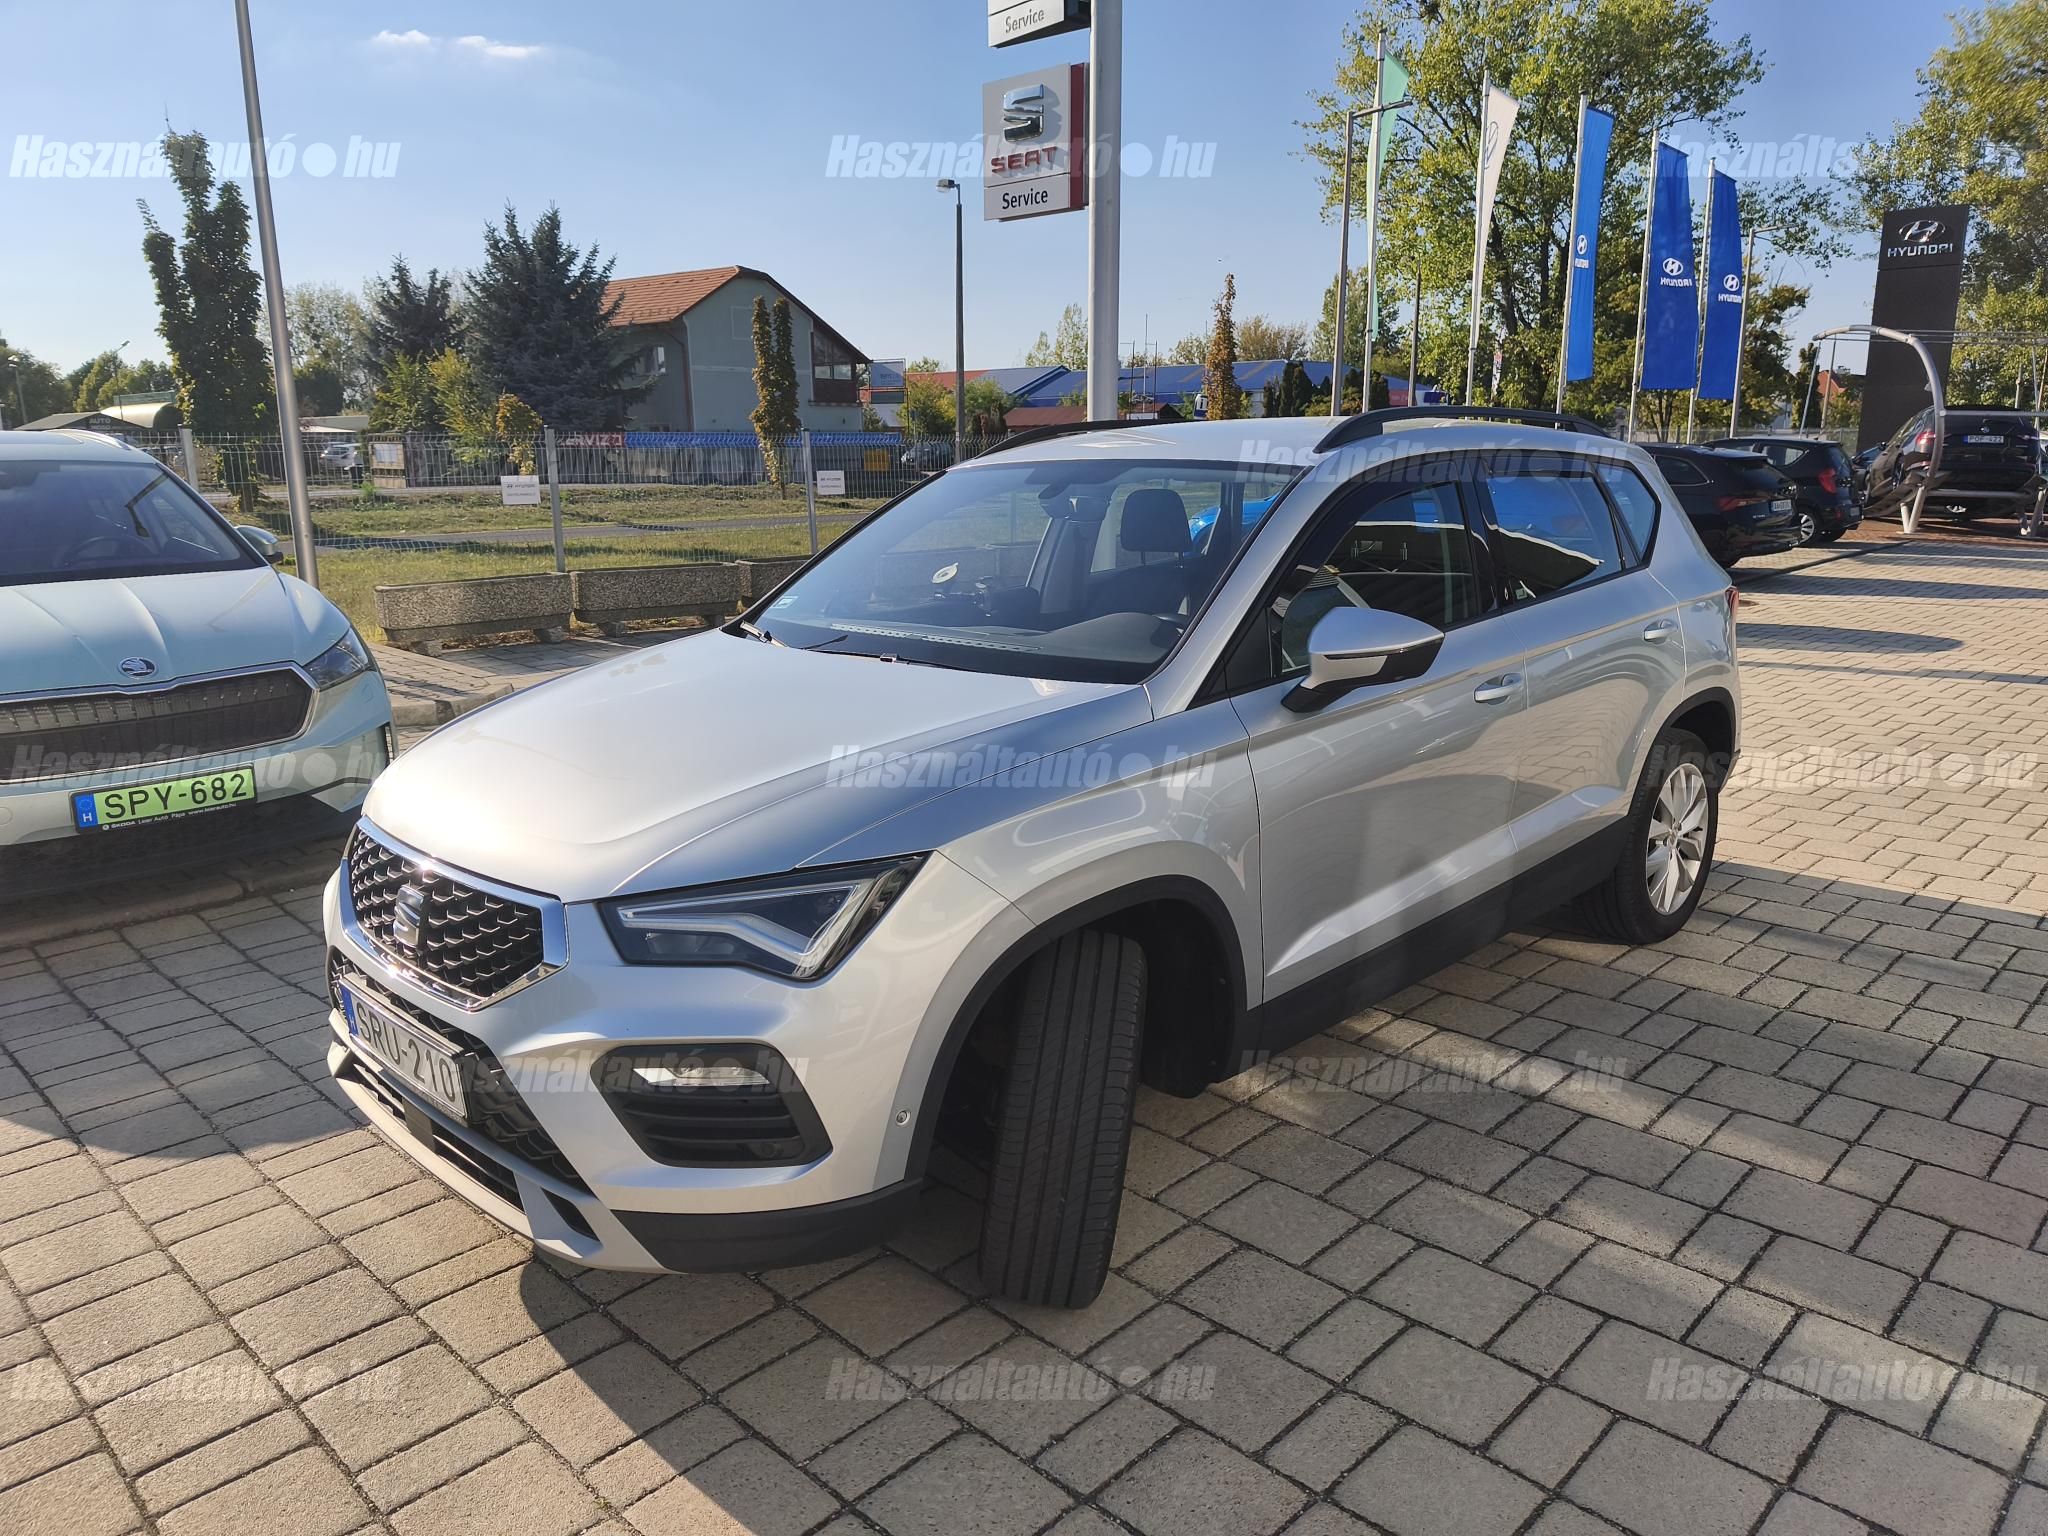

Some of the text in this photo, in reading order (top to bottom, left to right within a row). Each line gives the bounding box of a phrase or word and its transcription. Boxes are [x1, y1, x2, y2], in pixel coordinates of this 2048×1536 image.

[1005, 9, 1045, 34] Service
[990, 146, 1058, 174] SEAT
[1002, 188, 1049, 210] Service
[104, 773, 247, 819] SPY-682
[82, 813, 93, 823] H
[356, 1001, 456, 1103] SRU-210
